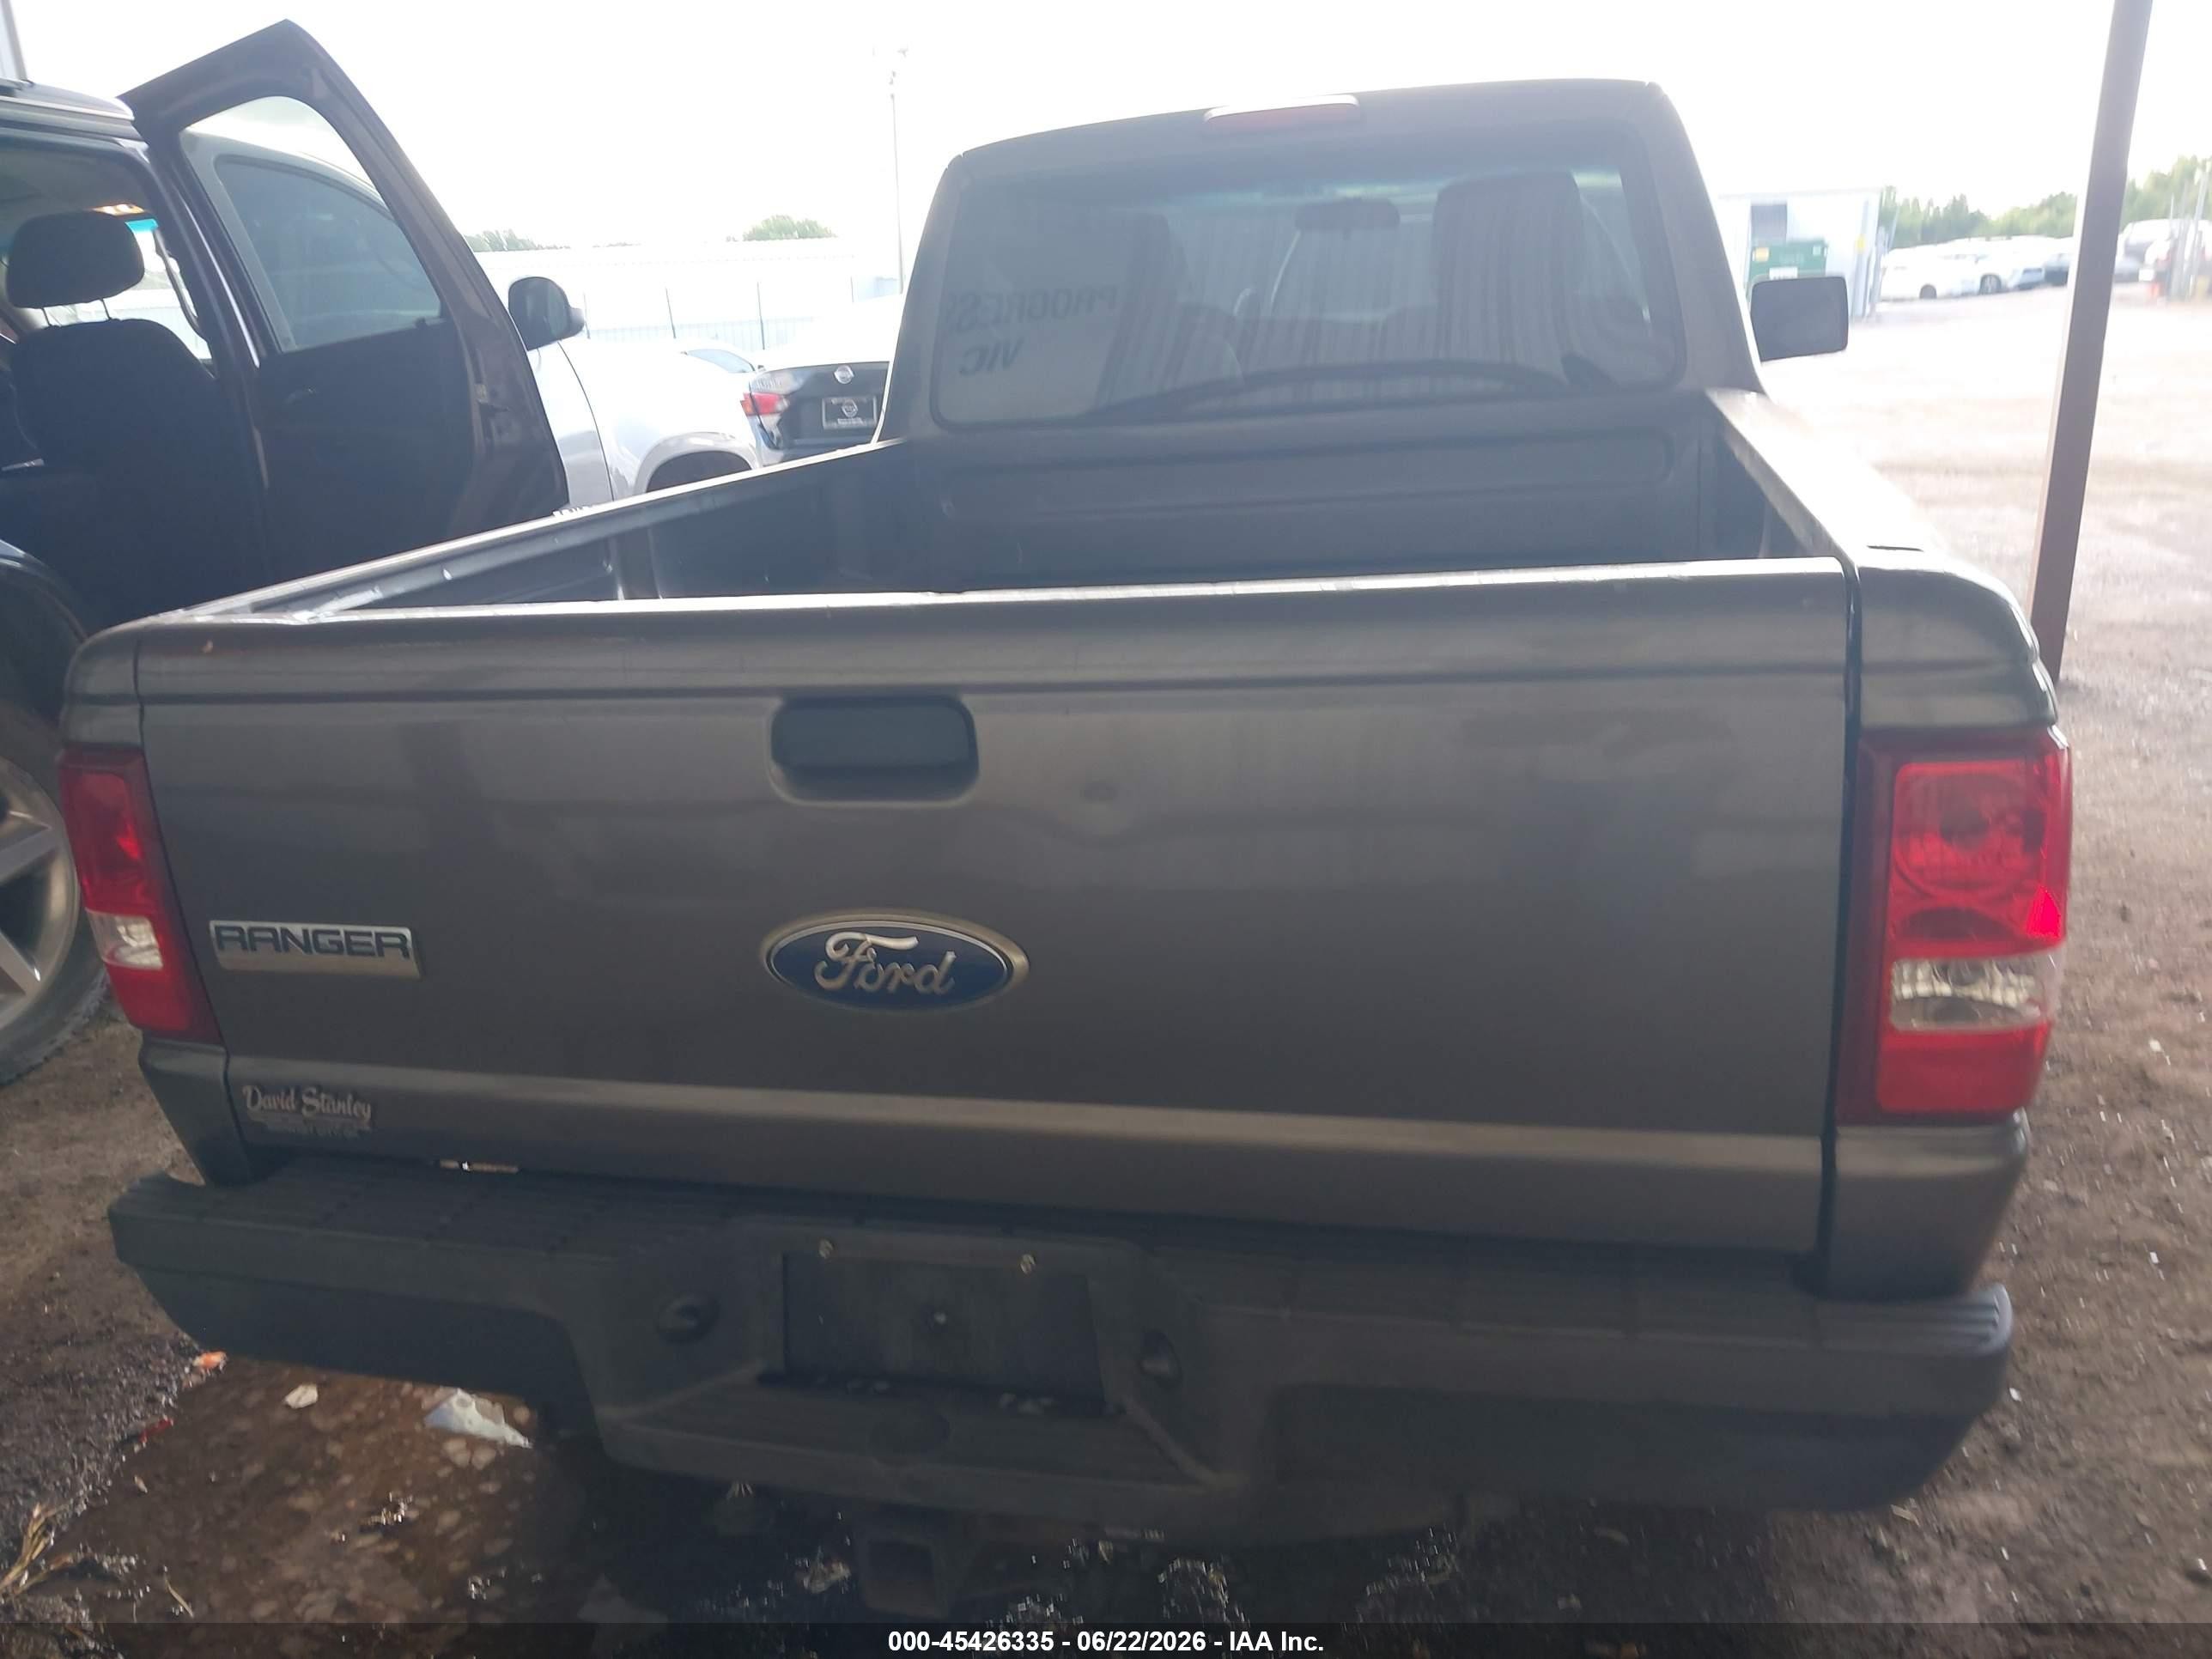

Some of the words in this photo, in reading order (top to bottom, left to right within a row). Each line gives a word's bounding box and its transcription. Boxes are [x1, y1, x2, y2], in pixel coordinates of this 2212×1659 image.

[213, 924, 411, 959] RANGER
[813, 931, 958, 995] Ford
[241, 1084, 296, 1113] David
[301, 1086, 372, 1124] Stanley
